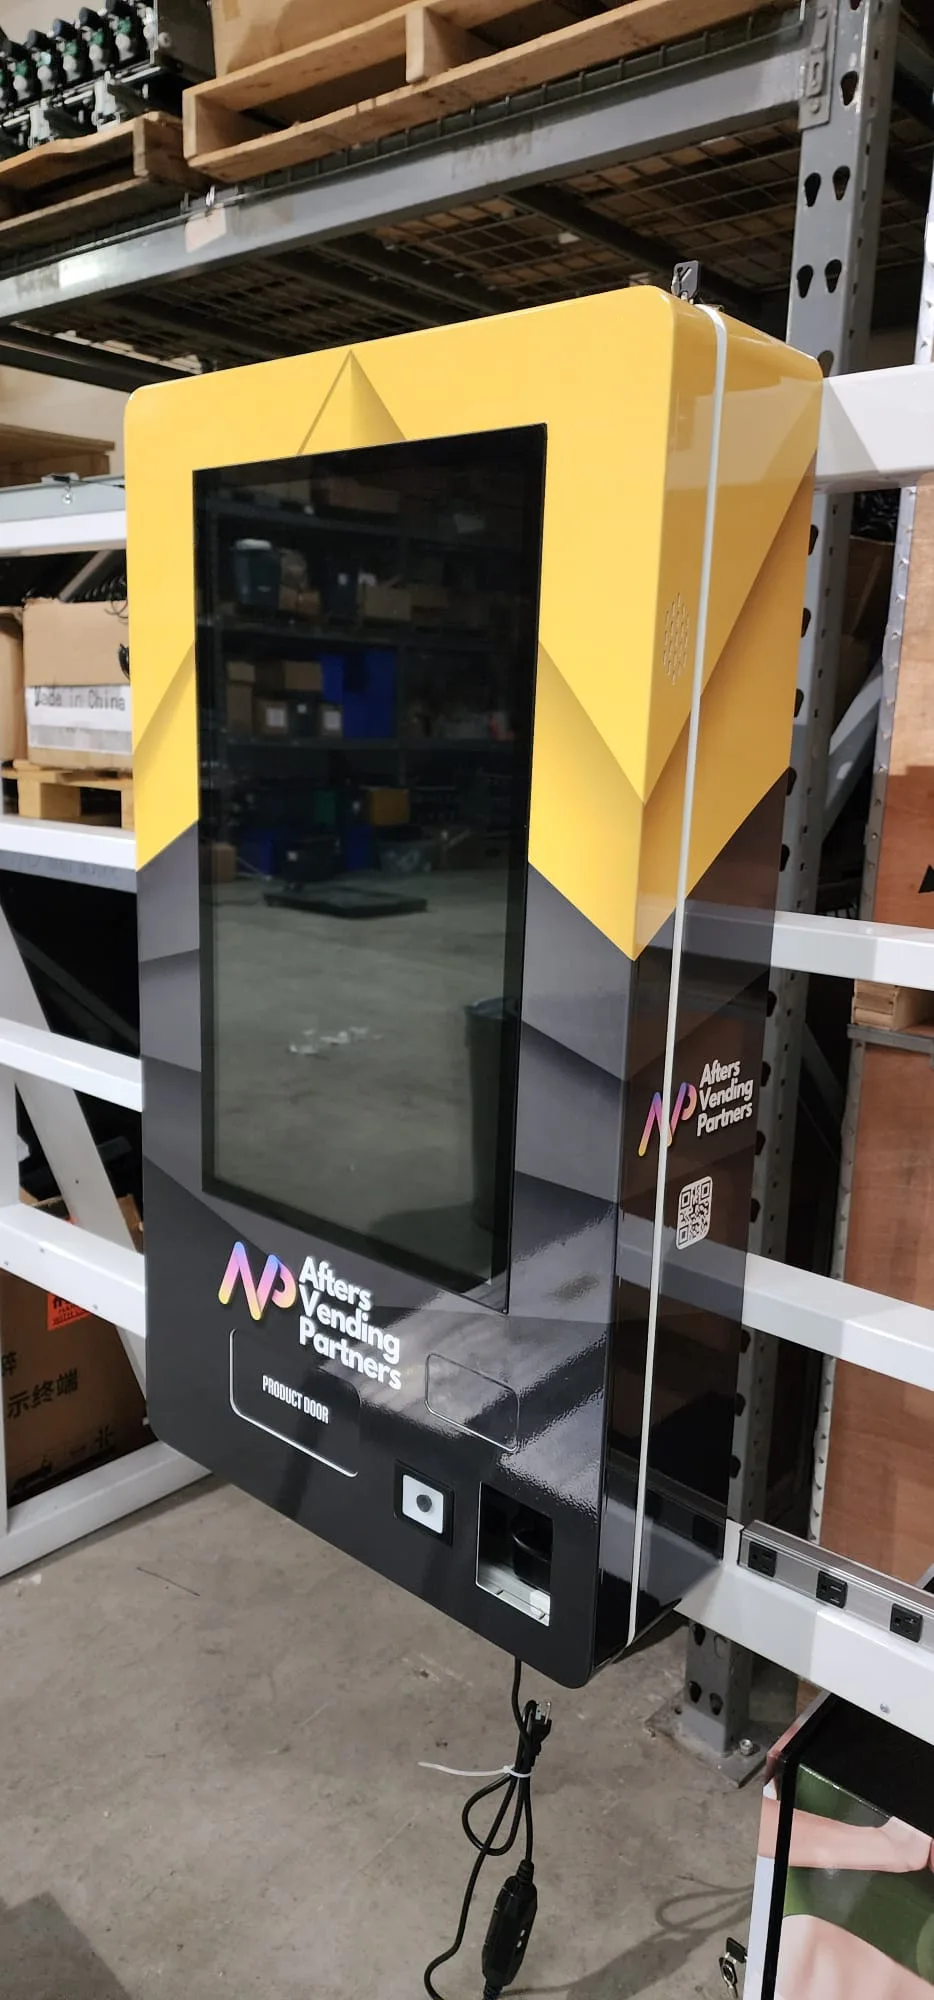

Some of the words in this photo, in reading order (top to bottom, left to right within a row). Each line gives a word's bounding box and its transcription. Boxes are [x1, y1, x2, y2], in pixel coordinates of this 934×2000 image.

[88, 688, 126, 711] China
[699, 1077, 754, 1111] Vending
[700, 1059, 741, 1089] Afters
[697, 1102, 753, 1137] Partners
[299, 1255, 373, 1312] Afters
[299, 1283, 400, 1364] Vending
[299, 1315, 402, 1390] Partners
[262, 1375, 302, 1410] PRODUCT
[303, 1395, 329, 1424] DOOR
